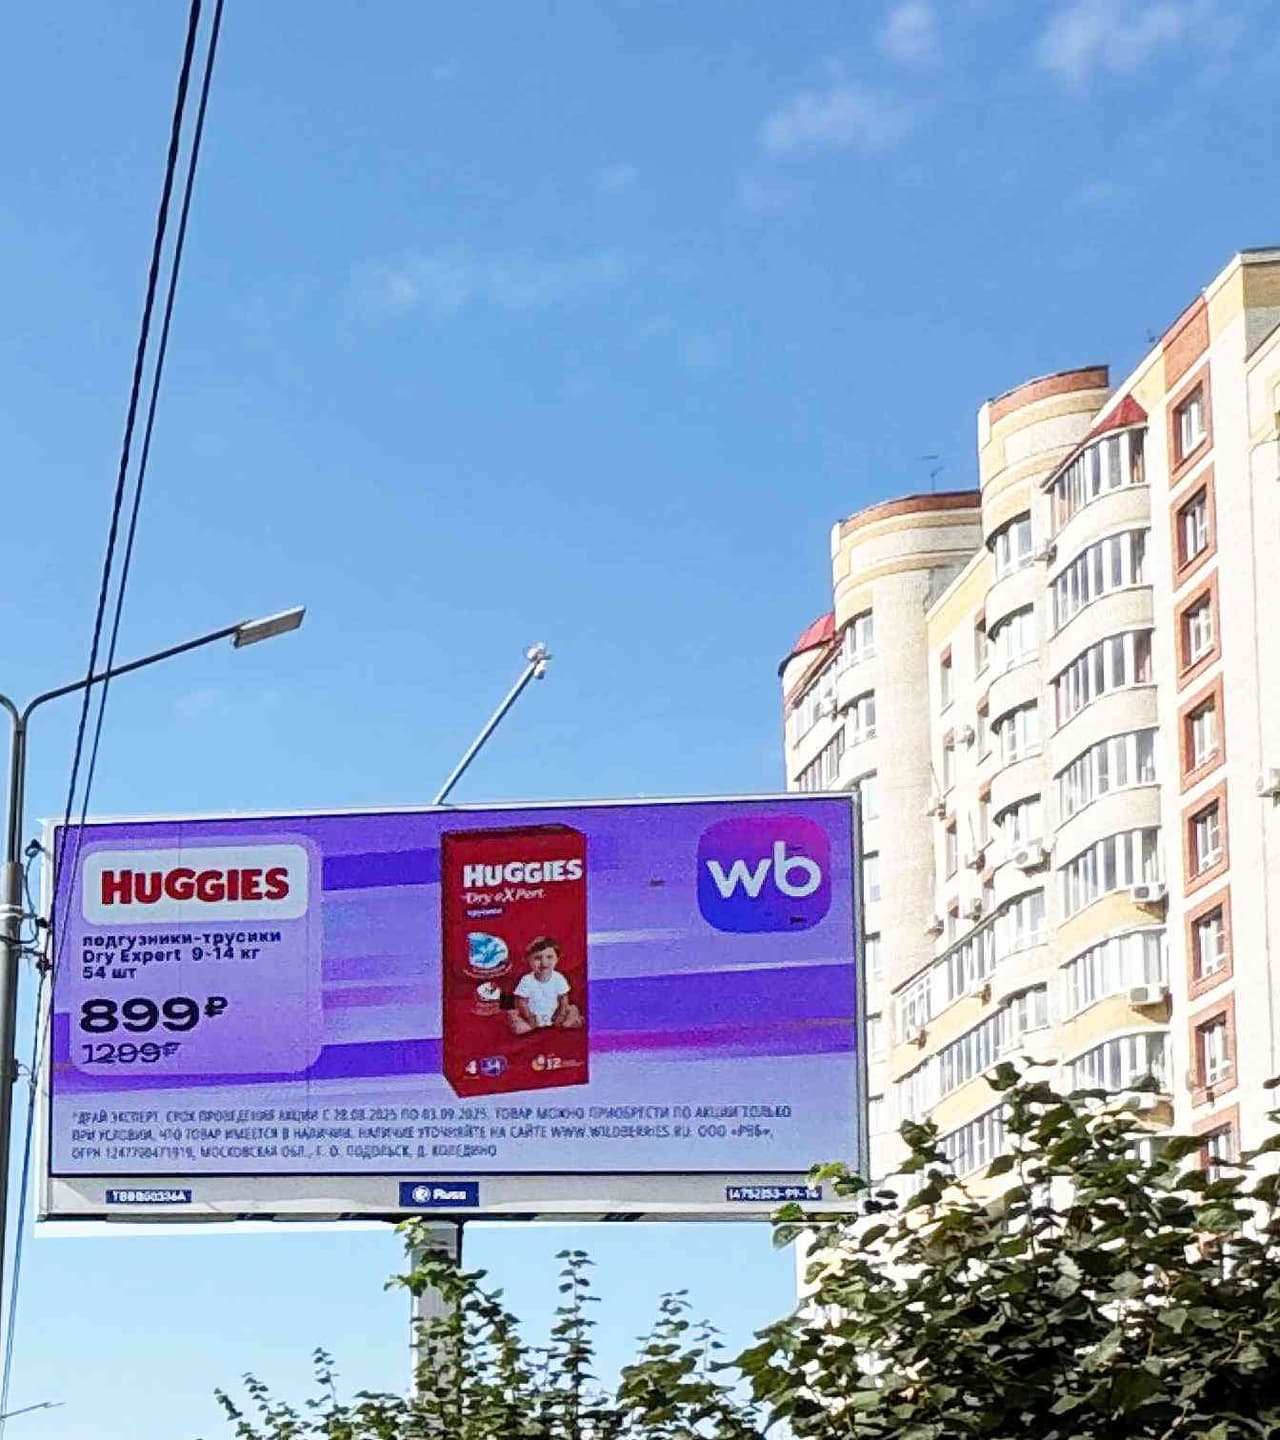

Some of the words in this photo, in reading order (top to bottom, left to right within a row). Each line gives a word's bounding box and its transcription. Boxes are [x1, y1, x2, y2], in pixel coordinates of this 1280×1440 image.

[464, 859, 582, 888] HUGGIES
[706, 840, 821, 898] wb
[101, 867, 289, 905] HUGGIES
[82, 931, 281, 951] подгузники-трусики
[82, 950, 115, 966] Dry
[120, 948, 181, 967] Expert
[192, 947, 234, 961] 9-14
[241, 948, 261, 960] кг
[82, 966, 106, 979] 54
[112, 967, 137, 979] шт
